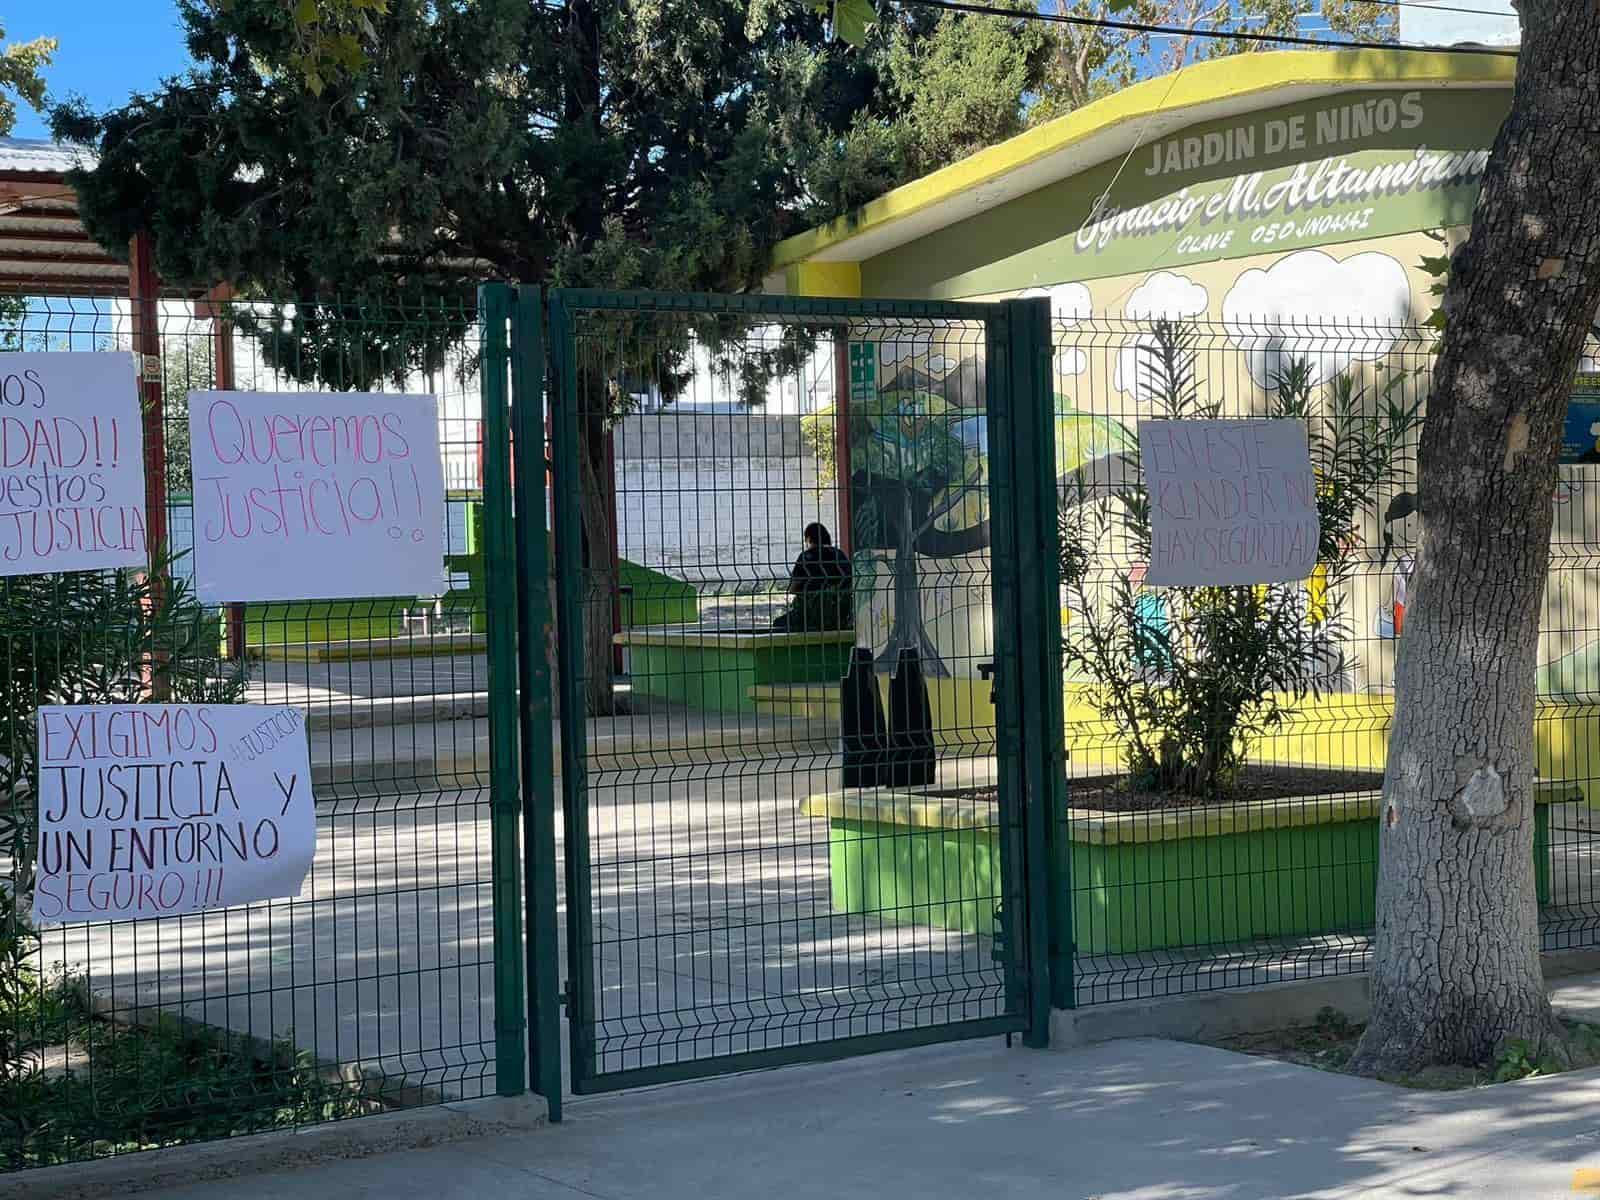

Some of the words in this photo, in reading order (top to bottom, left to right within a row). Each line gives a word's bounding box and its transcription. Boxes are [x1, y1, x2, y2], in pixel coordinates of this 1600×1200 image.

[1145, 124, 1256, 177] JARDIN
[1264, 116, 1306, 154] DE
[1315, 91, 1424, 145] NIÑOS
[1076, 187, 1204, 250] Ignacio
[1263, 144, 1493, 212] Altamiran
[1176, 229, 1235, 254] CLAVE
[207, 400, 411, 468] Queremos
[1147, 428, 1200, 474] EN
[1203, 423, 1273, 474] ESTE
[1157, 471, 1278, 520] KINDER
[0, 505, 149, 561] JUSTICIA
[1156, 527, 1199, 569] HAY
[42, 707, 218, 761] EXIGIMOS
[41, 760, 240, 823] JUSTICIA
[41, 828, 92, 876] UN
[109, 818, 280, 873] ENTORNO
